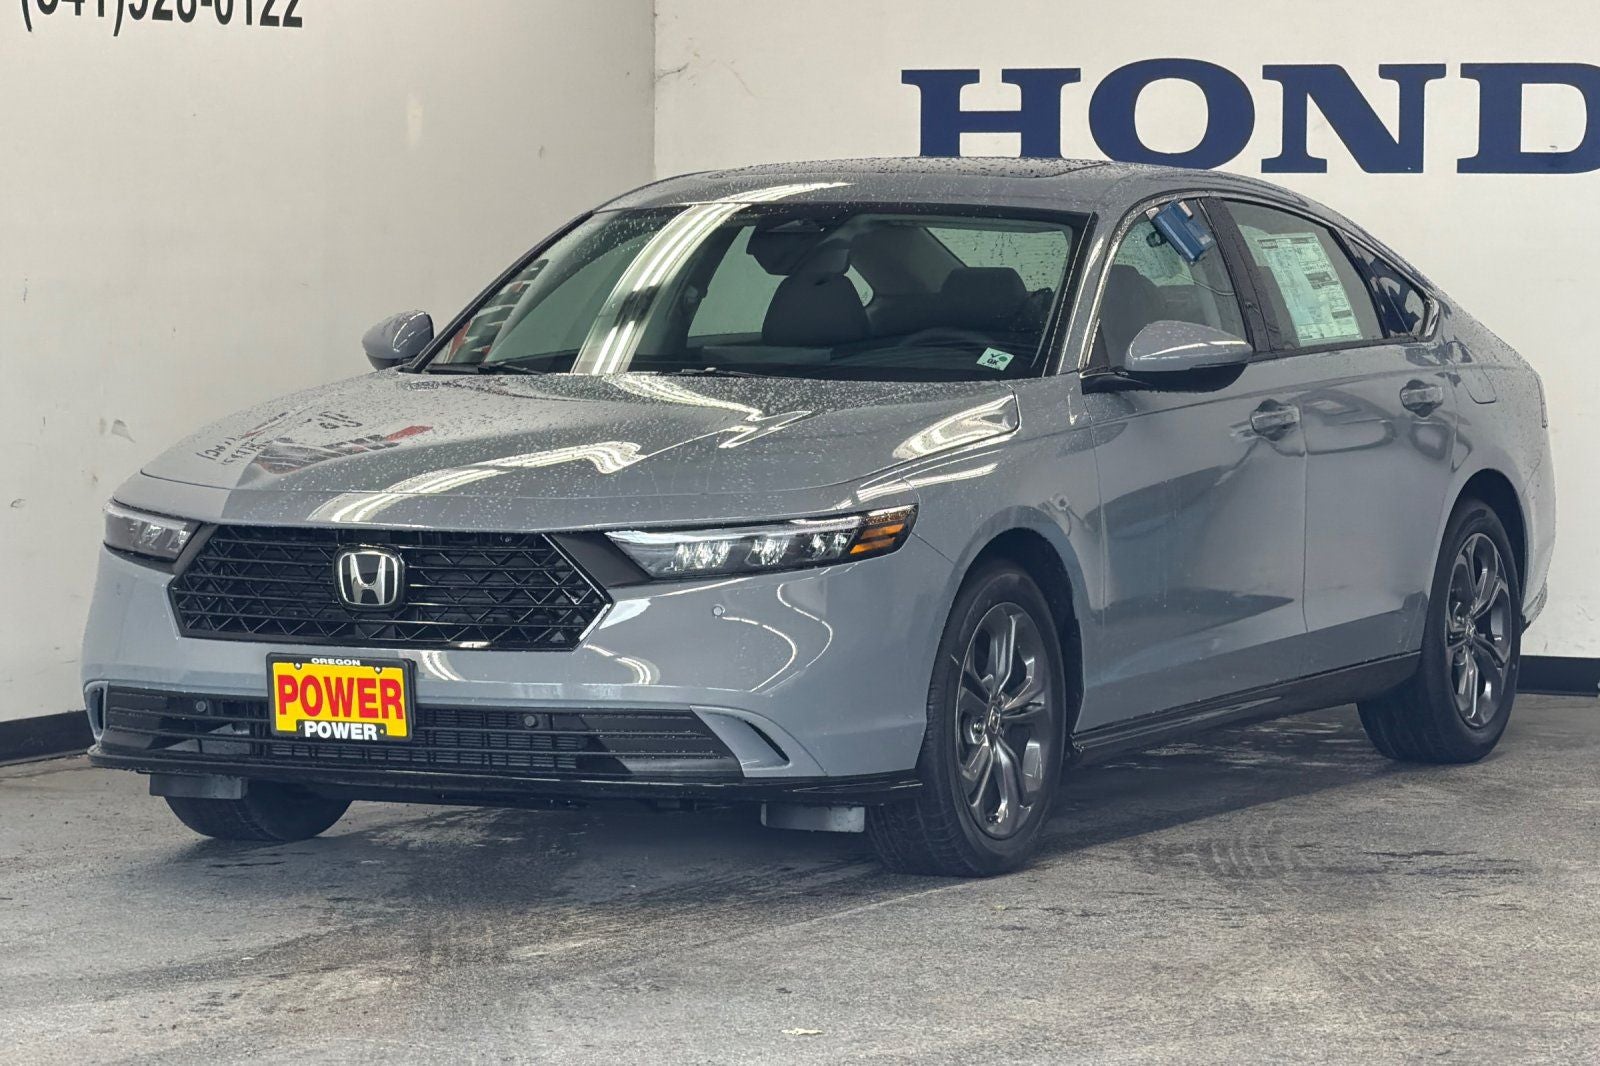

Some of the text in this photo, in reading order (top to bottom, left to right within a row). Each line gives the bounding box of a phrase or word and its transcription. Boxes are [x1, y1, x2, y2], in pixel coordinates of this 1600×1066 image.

[311, 657, 361, 667] OREGON
[277, 674, 404, 720] POWER
[304, 720, 378, 741] POWER
